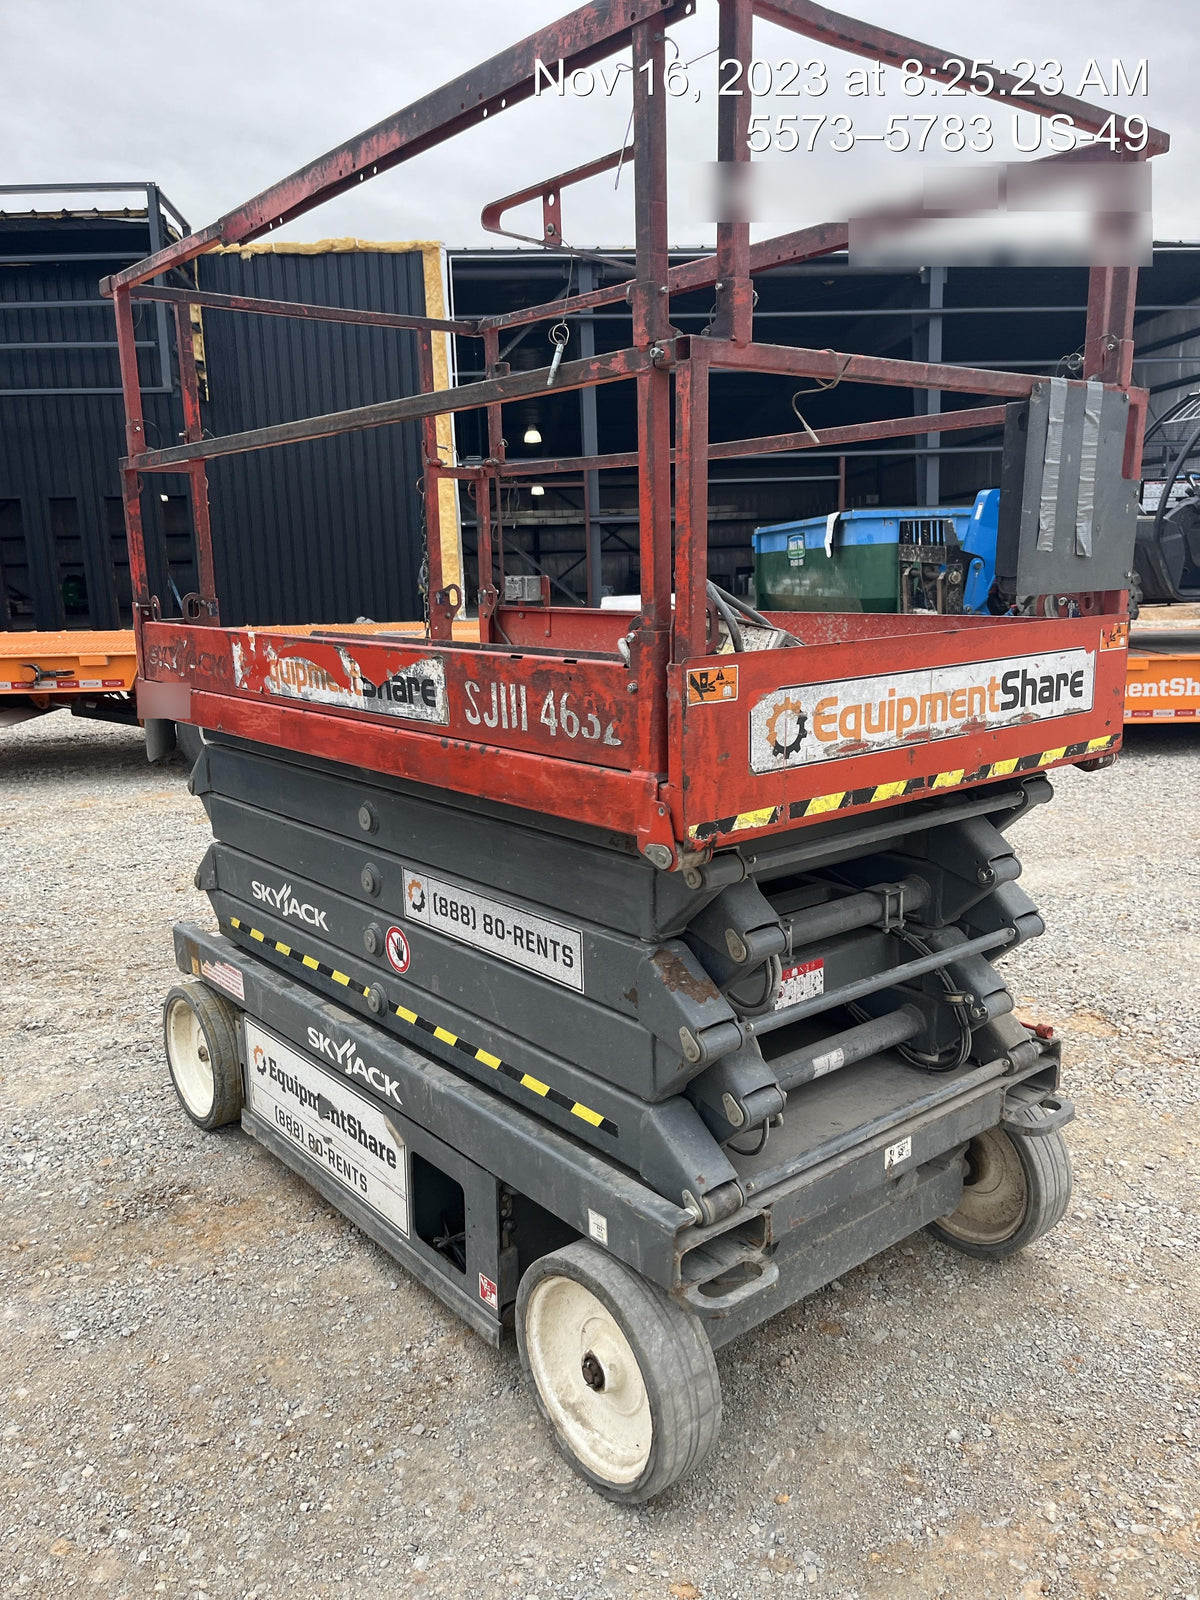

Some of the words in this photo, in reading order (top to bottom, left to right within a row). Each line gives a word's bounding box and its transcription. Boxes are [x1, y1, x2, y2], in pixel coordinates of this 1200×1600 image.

[813, 668, 1084, 743] EquipmentShare
[251, 880, 330, 932] SKYJACK
[433, 892, 477, 931] (888)
[482, 913, 574, 969] 80-RENTS
[307, 1026, 403, 1106] SKYJACK
[274, 1104, 305, 1144] (888)
[308, 1132, 369, 1194] 80-RENTS
